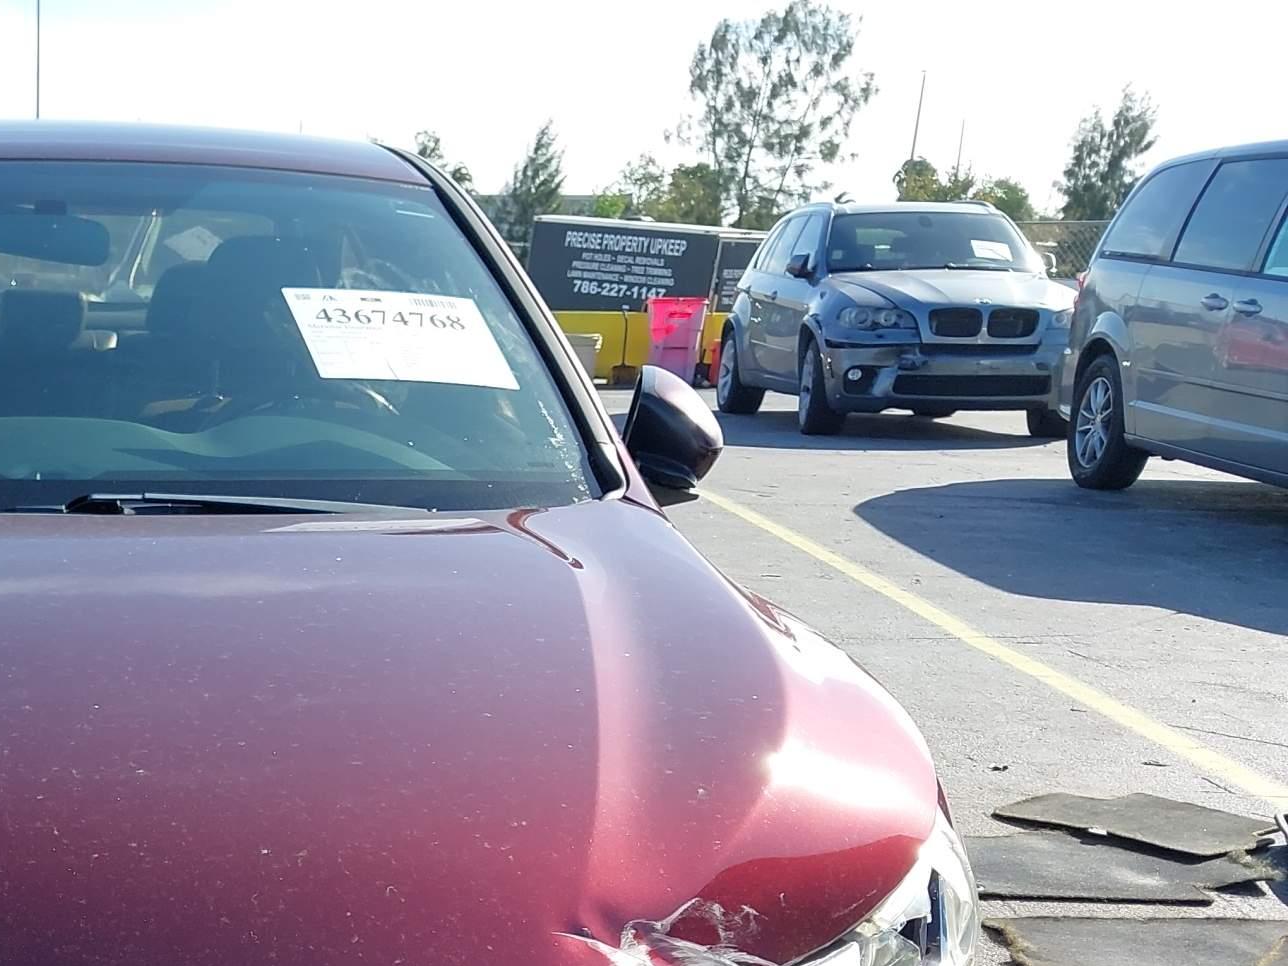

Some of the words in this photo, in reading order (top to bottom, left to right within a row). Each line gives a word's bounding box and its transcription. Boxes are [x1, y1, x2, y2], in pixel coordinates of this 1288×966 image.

[565, 231, 602, 250] PRECISE
[602, 233, 650, 254] PROPERTY
[650, 237, 687, 257] UPKEEP
[573, 280, 666, 299] 786-227-1147
[315, 307, 465, 331] 43674768
